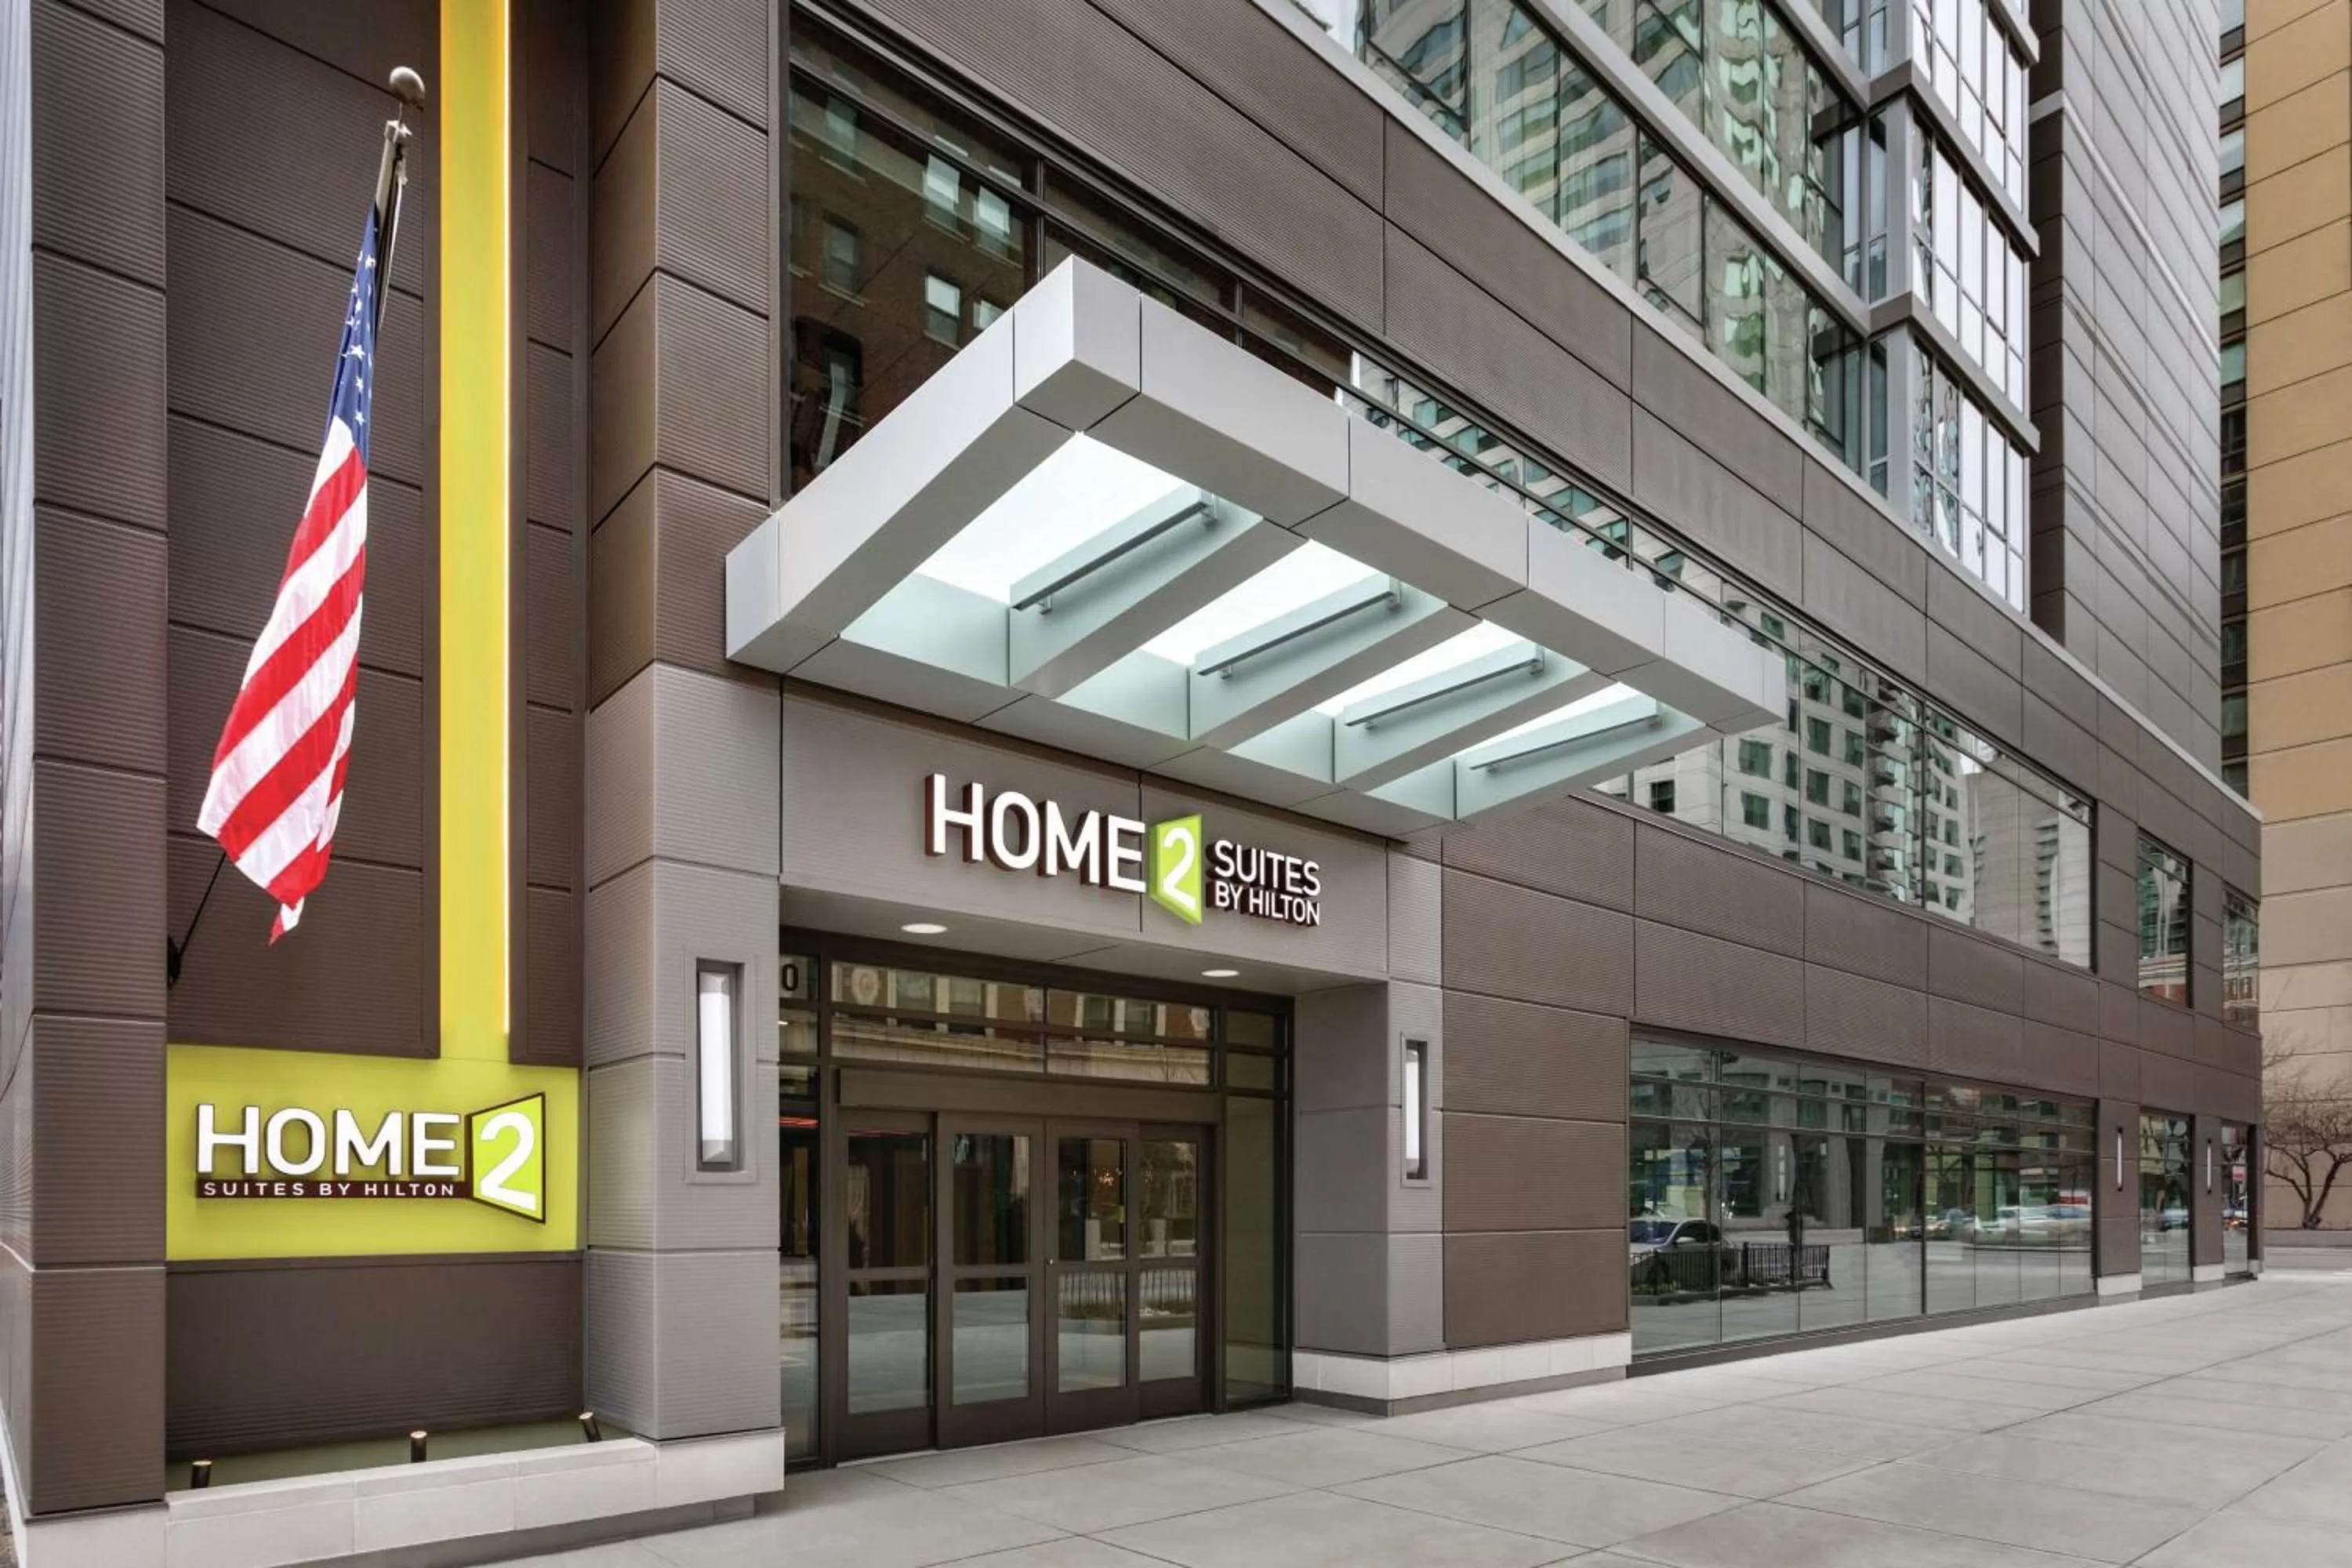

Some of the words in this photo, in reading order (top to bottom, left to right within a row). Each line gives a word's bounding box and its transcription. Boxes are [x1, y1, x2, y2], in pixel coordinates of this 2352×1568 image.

[1214, 840, 1322, 897] SUITES
[1215, 880, 1244, 911] BY
[1249, 887, 1321, 927] HILTON
[202, 1181, 305, 1196] SUITES
[319, 1182, 351, 1196] BY
[364, 1182, 456, 1196] HILTON
